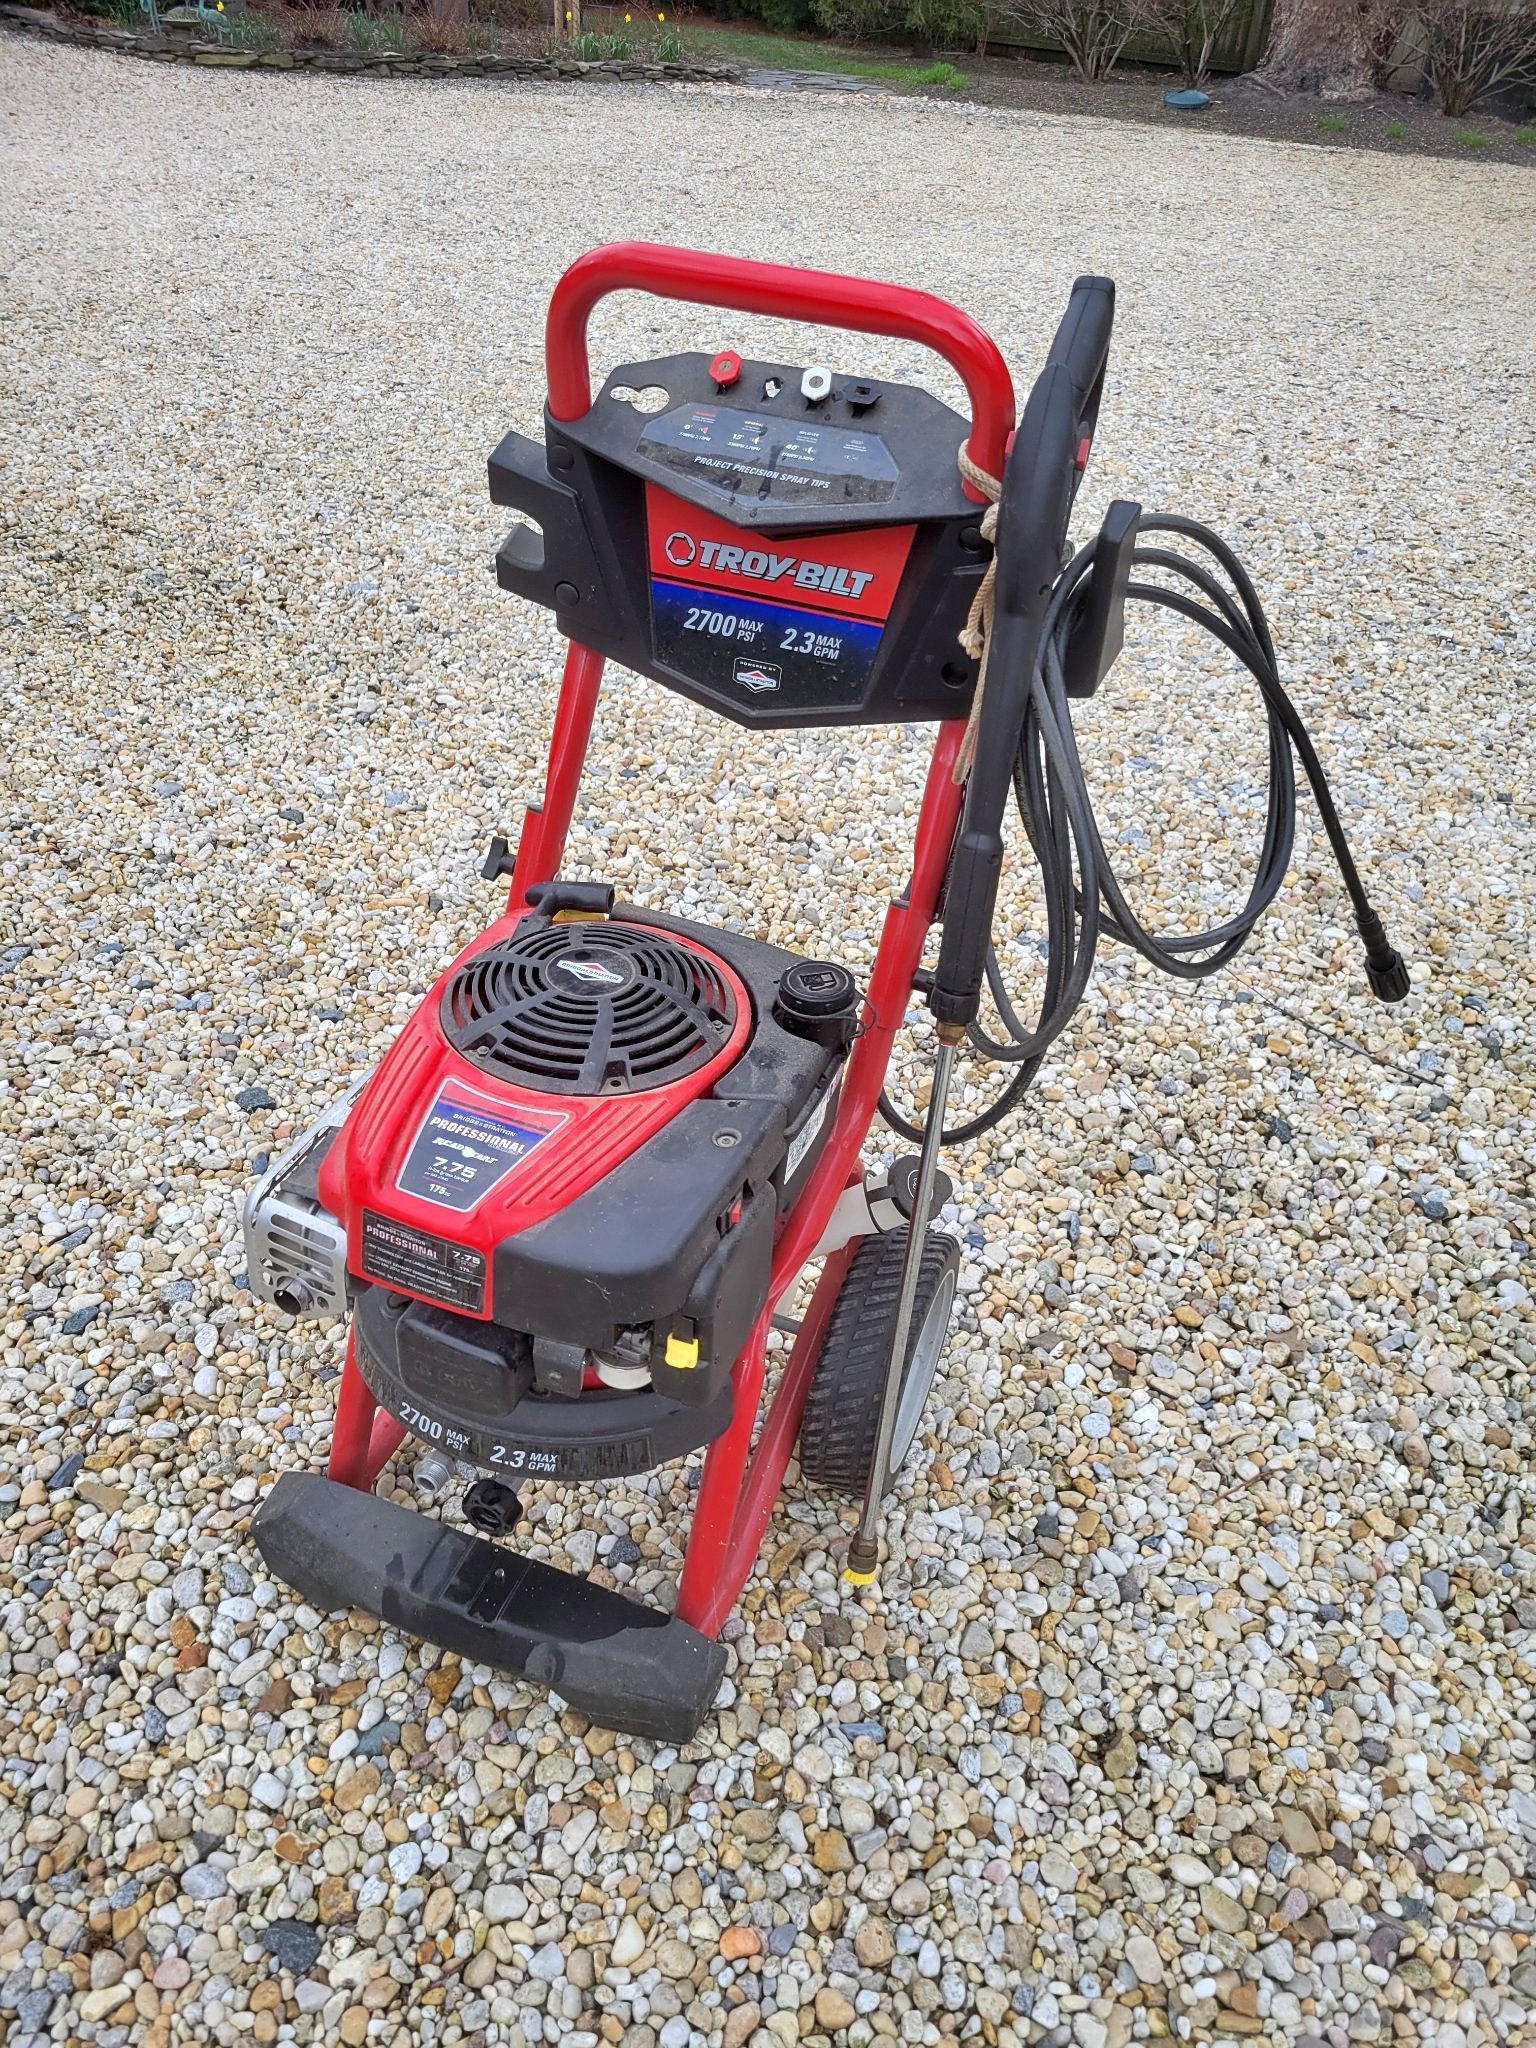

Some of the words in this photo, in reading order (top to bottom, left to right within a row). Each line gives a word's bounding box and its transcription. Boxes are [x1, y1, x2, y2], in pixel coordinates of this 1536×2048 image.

[693, 456, 733, 470] PROJECT
[733, 463, 780, 480] PRECISION
[780, 473, 810, 486] SPRAY
[810, 479, 831, 489] TIPS
[699, 539, 874, 600] TROY-BILT
[683, 607, 737, 637] 2700
[738, 619, 764, 633] MAX
[736, 630, 755, 643] PSI
[779, 628, 814, 654] 2.3
[815, 635, 843, 650] MAX
[813, 646, 840, 661] GPM
[429, 1116, 525, 1155] PROFESSIONAL
[432, 1156, 478, 1179] 7.75
[366, 1225, 438, 1259] PROFESSIONAL
[452, 1250, 481, 1265] 7.75
[399, 1401, 443, 1440] 2700
[446, 1428, 471, 1446] MAX
[446, 1438, 463, 1451] PSI
[489, 1445, 526, 1469] 2.3
[529, 1452, 559, 1464] MAX
[528, 1461, 557, 1473] GPM
